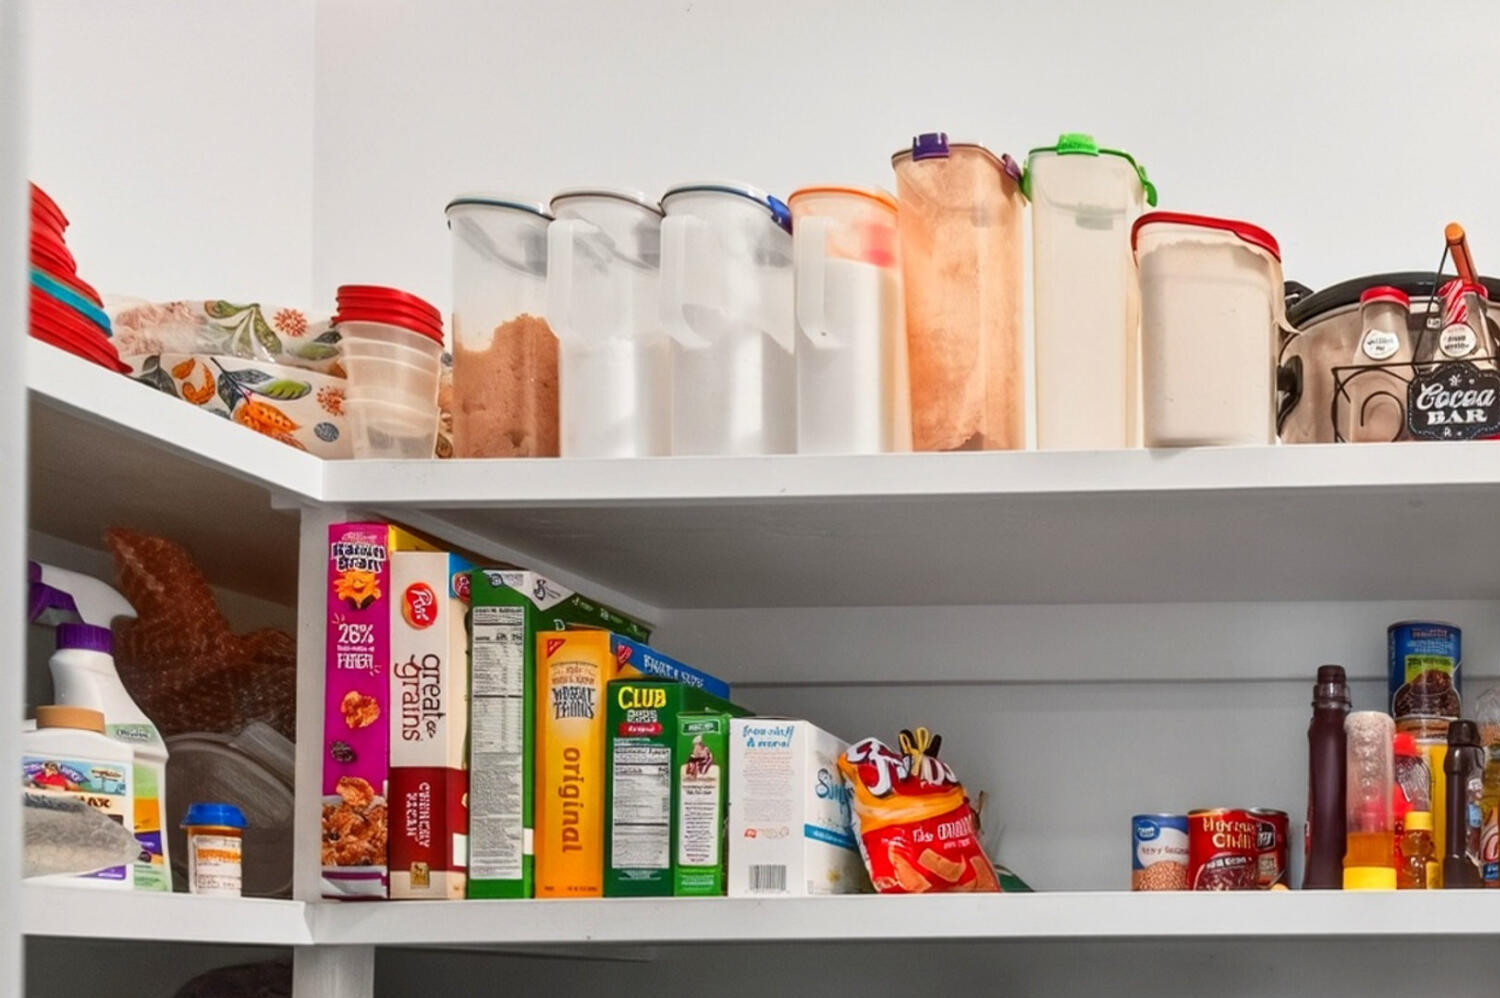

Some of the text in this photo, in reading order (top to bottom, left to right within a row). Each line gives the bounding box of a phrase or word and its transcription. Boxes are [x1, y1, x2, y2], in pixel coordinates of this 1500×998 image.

[1416, 382, 1496, 411] Cocoa
[1427, 409, 1488, 426] BAR
[394, 654, 422, 742] grains
[421, 653, 446, 720] great
[617, 686, 667, 709] CLUB
[558, 747, 585, 853] original
